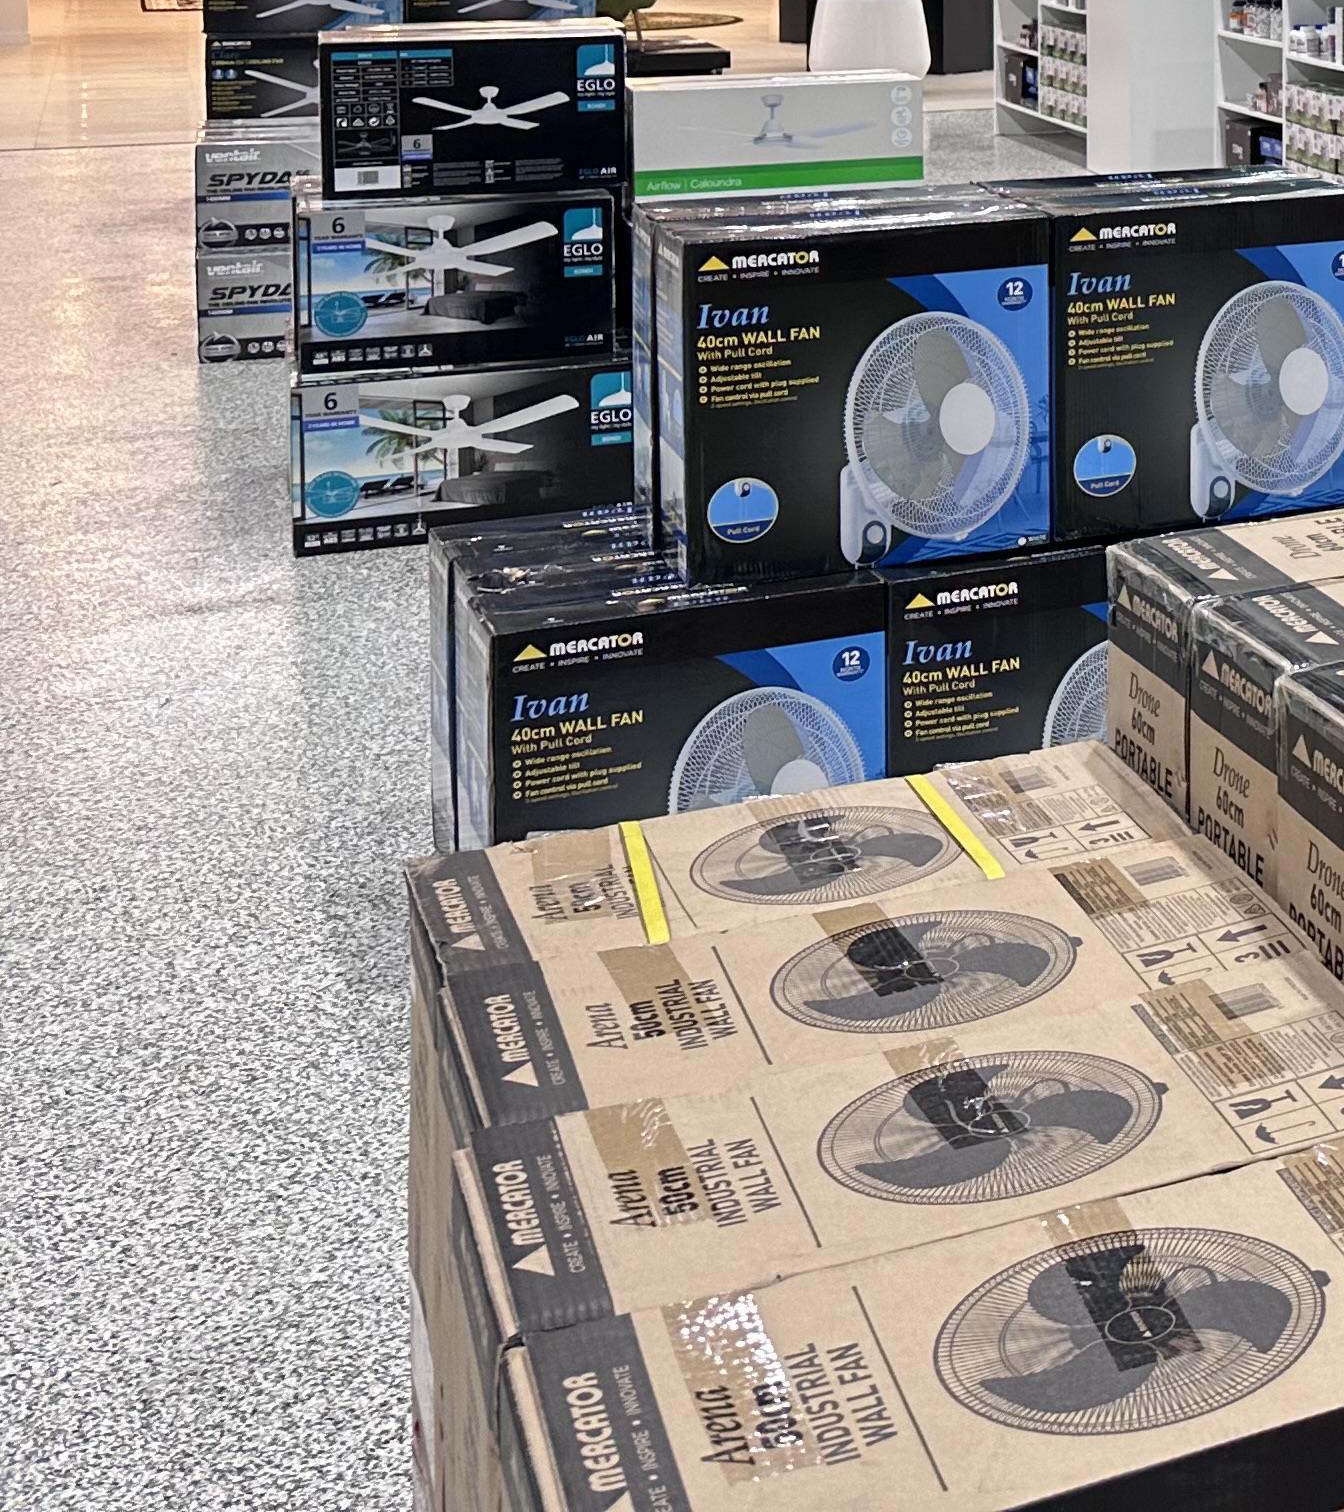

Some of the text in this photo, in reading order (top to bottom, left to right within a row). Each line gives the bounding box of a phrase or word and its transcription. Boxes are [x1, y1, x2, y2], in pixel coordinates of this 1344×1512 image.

[577, 78, 616, 92] EGLO
[412, 138, 422, 149] 6
[600, 167, 617, 175] AIR
[646, 176, 742, 192] Airflow Caloundra
[331, 216, 345, 234] 6
[1099, 222, 1177, 241] MERCATOR
[563, 243, 603, 257] EGLO
[731, 250, 820, 270] MERCATOR
[1005, 280, 1024, 296] 12
[1067, 271, 1132, 297] Ivan
[696, 303, 771, 330] Ivan
[1067, 293, 1177, 315] 40cm WALL FAN
[586, 333, 604, 342] AIR
[697, 326, 821, 349] 40cm WALL FAN
[323, 391, 338, 410] 6
[590, 409, 632, 424] EGLO
[937, 581, 1019, 606] MERCATOR
[1130, 593, 1180, 643] MERCATOR
[549, 631, 644, 657] MERCATOR
[840, 650, 860, 667] 12
[902, 639, 974, 666] Ivan
[1128, 671, 1162, 718] Drone
[1218, 663, 1276, 717] MERCATOR
[510, 691, 590, 724] Ivan
[511, 709, 644, 743] 40cm WALL FAN
[1131, 707, 1156, 747] 60cm
[511, 734, 593, 755] With Pull Cord
[524, 763, 568, 778] Adjustable
[525, 776, 552, 788] Power
[608, 761, 643, 775] supplied
[1114, 727, 1174, 799] PORTABLE
[1213, 746, 1251, 799] Drone
[1215, 786, 1245, 830] 60cm
[1198, 805, 1266, 889] PORTABLE
[1309, 882, 1343, 935] 60cm
[585, 1001, 629, 1050] Arena
[629, 999, 667, 1041] 50cm
[655, 978, 709, 1051] INDUSTRIAL
[687, 977, 738, 1041] WALL FAN
[483, 993, 531, 1063] MERCATOR
[657, 1165, 700, 1218] 50cm
[686, 1138, 749, 1229] INDUSTRIAL
[724, 1138, 782, 1215] WALL FAN
[492, 1158, 547, 1247] MERCATOR
[608, 1168, 658, 1229] Arena
[783, 1342, 863, 1467] INDUSTRIAL
[826, 1341, 899, 1448] WALL FAN
[562, 1370, 628, 1494] MERCATOR
[695, 1384, 756, 1468] Arena
